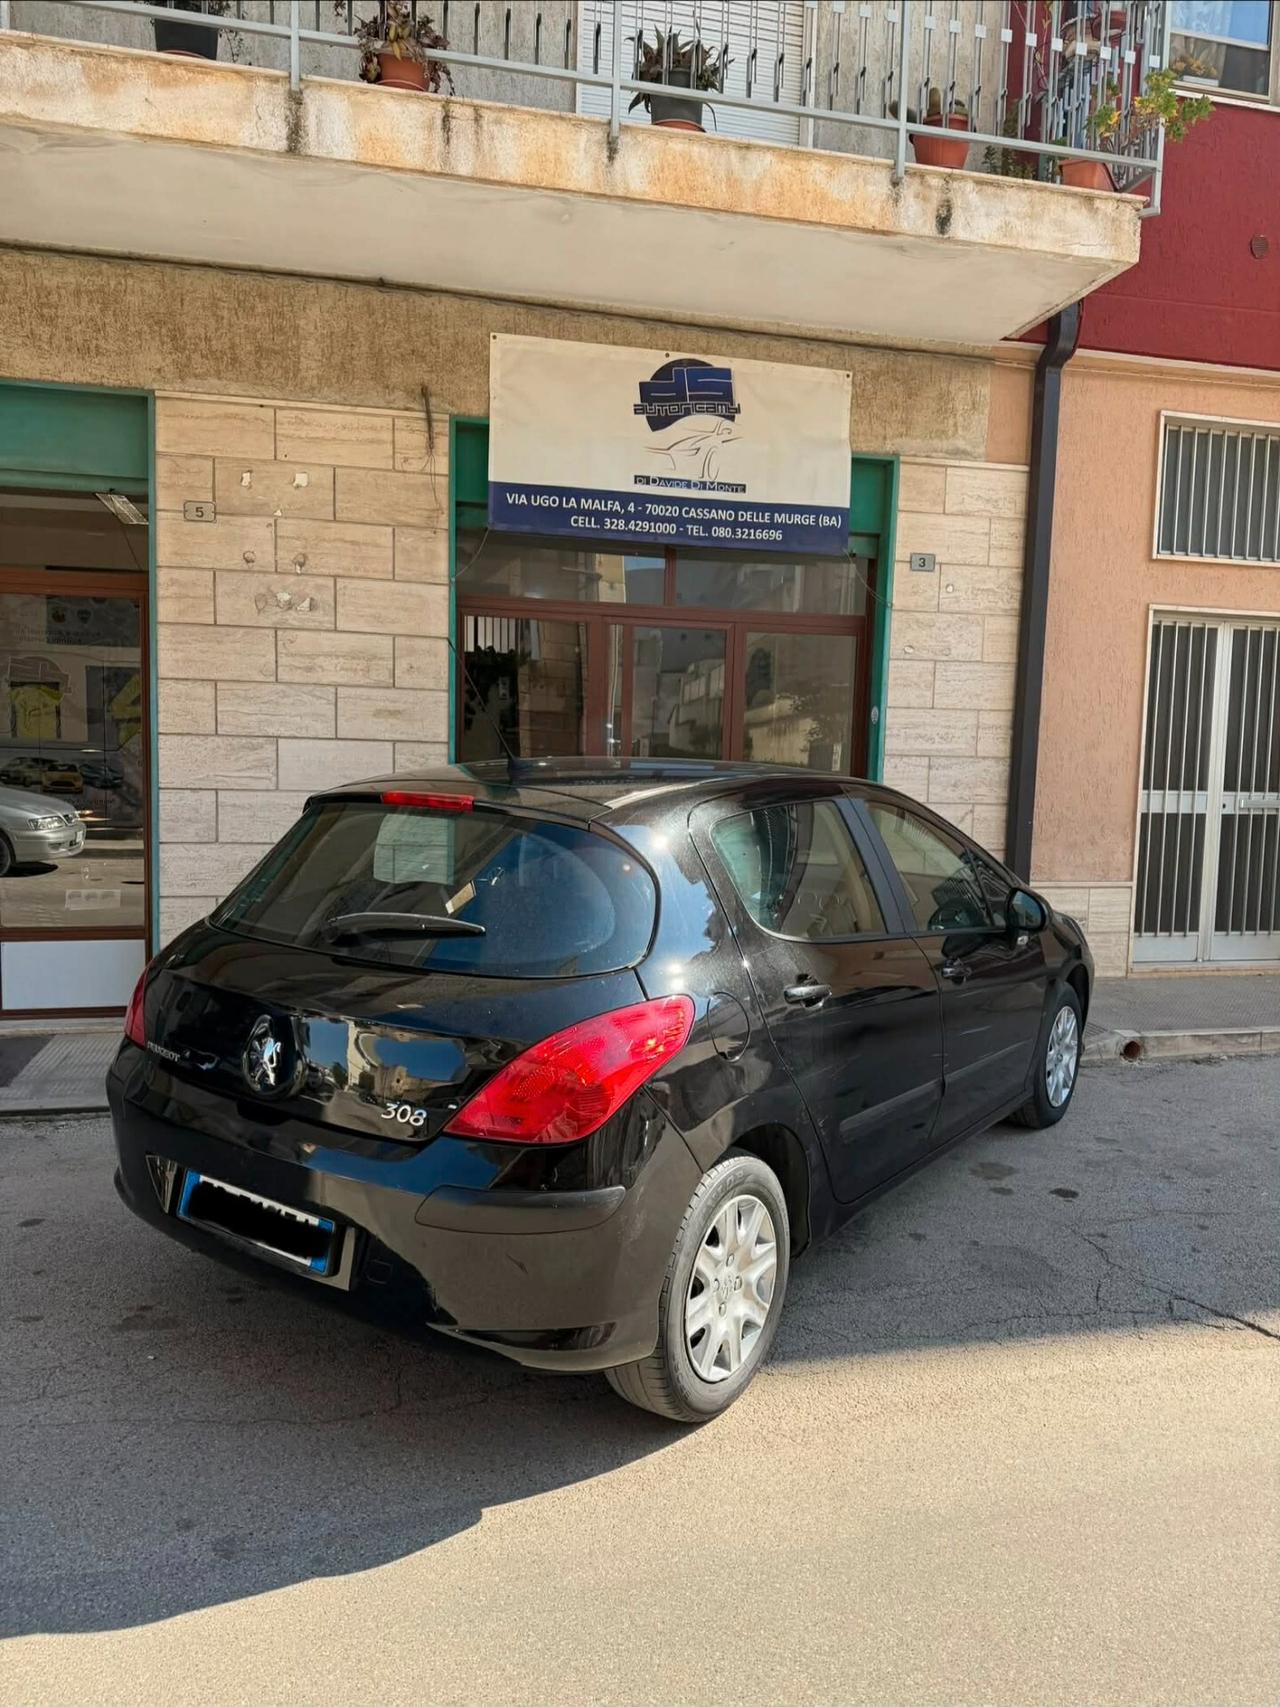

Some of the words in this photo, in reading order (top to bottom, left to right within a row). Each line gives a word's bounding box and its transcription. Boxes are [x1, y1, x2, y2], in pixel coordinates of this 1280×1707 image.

[649, 476, 688, 488] DAVIDE
[705, 482, 745, 493] MONTE
[195, 506, 204, 518] 5
[506, 492, 527, 505] VIA
[531, 495, 559, 507] UGO
[562, 497, 577, 508] LA
[580, 499, 625, 514] MALFA,
[627, 502, 635, 513] 4
[645, 503, 680, 517] 70020
[681, 506, 735, 521] CASSANO
[738, 511, 771, 523] DELLE
[773, 512, 816, 526] MURGE
[818, 514, 842, 528] (BA)
[570, 515, 600, 529] CELL.
[603, 518, 677, 535] 328.4291000
[686, 524, 709, 537] TEL.
[711, 526, 783, 541] 080.3216696
[918, 557, 926, 568] 3
[381, 1102, 427, 1126] 308
